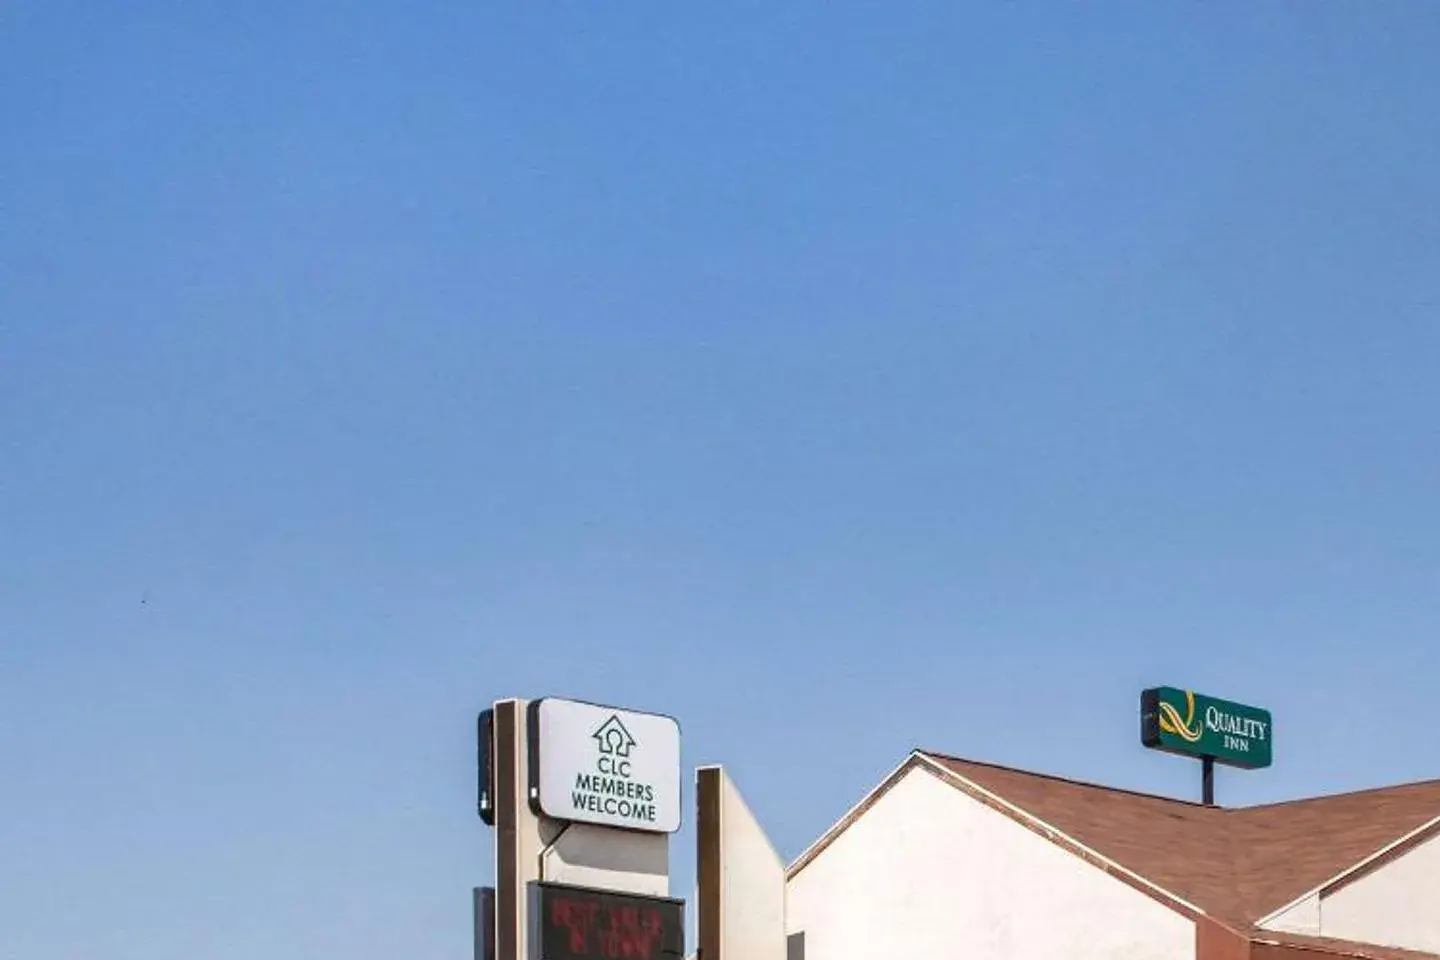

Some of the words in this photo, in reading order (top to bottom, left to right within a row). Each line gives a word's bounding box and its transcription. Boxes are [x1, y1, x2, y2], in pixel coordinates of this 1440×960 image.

[1205, 705, 1267, 740] QUALITY
[1223, 735, 1249, 752] INN
[598, 756, 631, 778] CLC
[576, 772, 654, 802] MEMBERS
[571, 791, 656, 821] WELCOME
